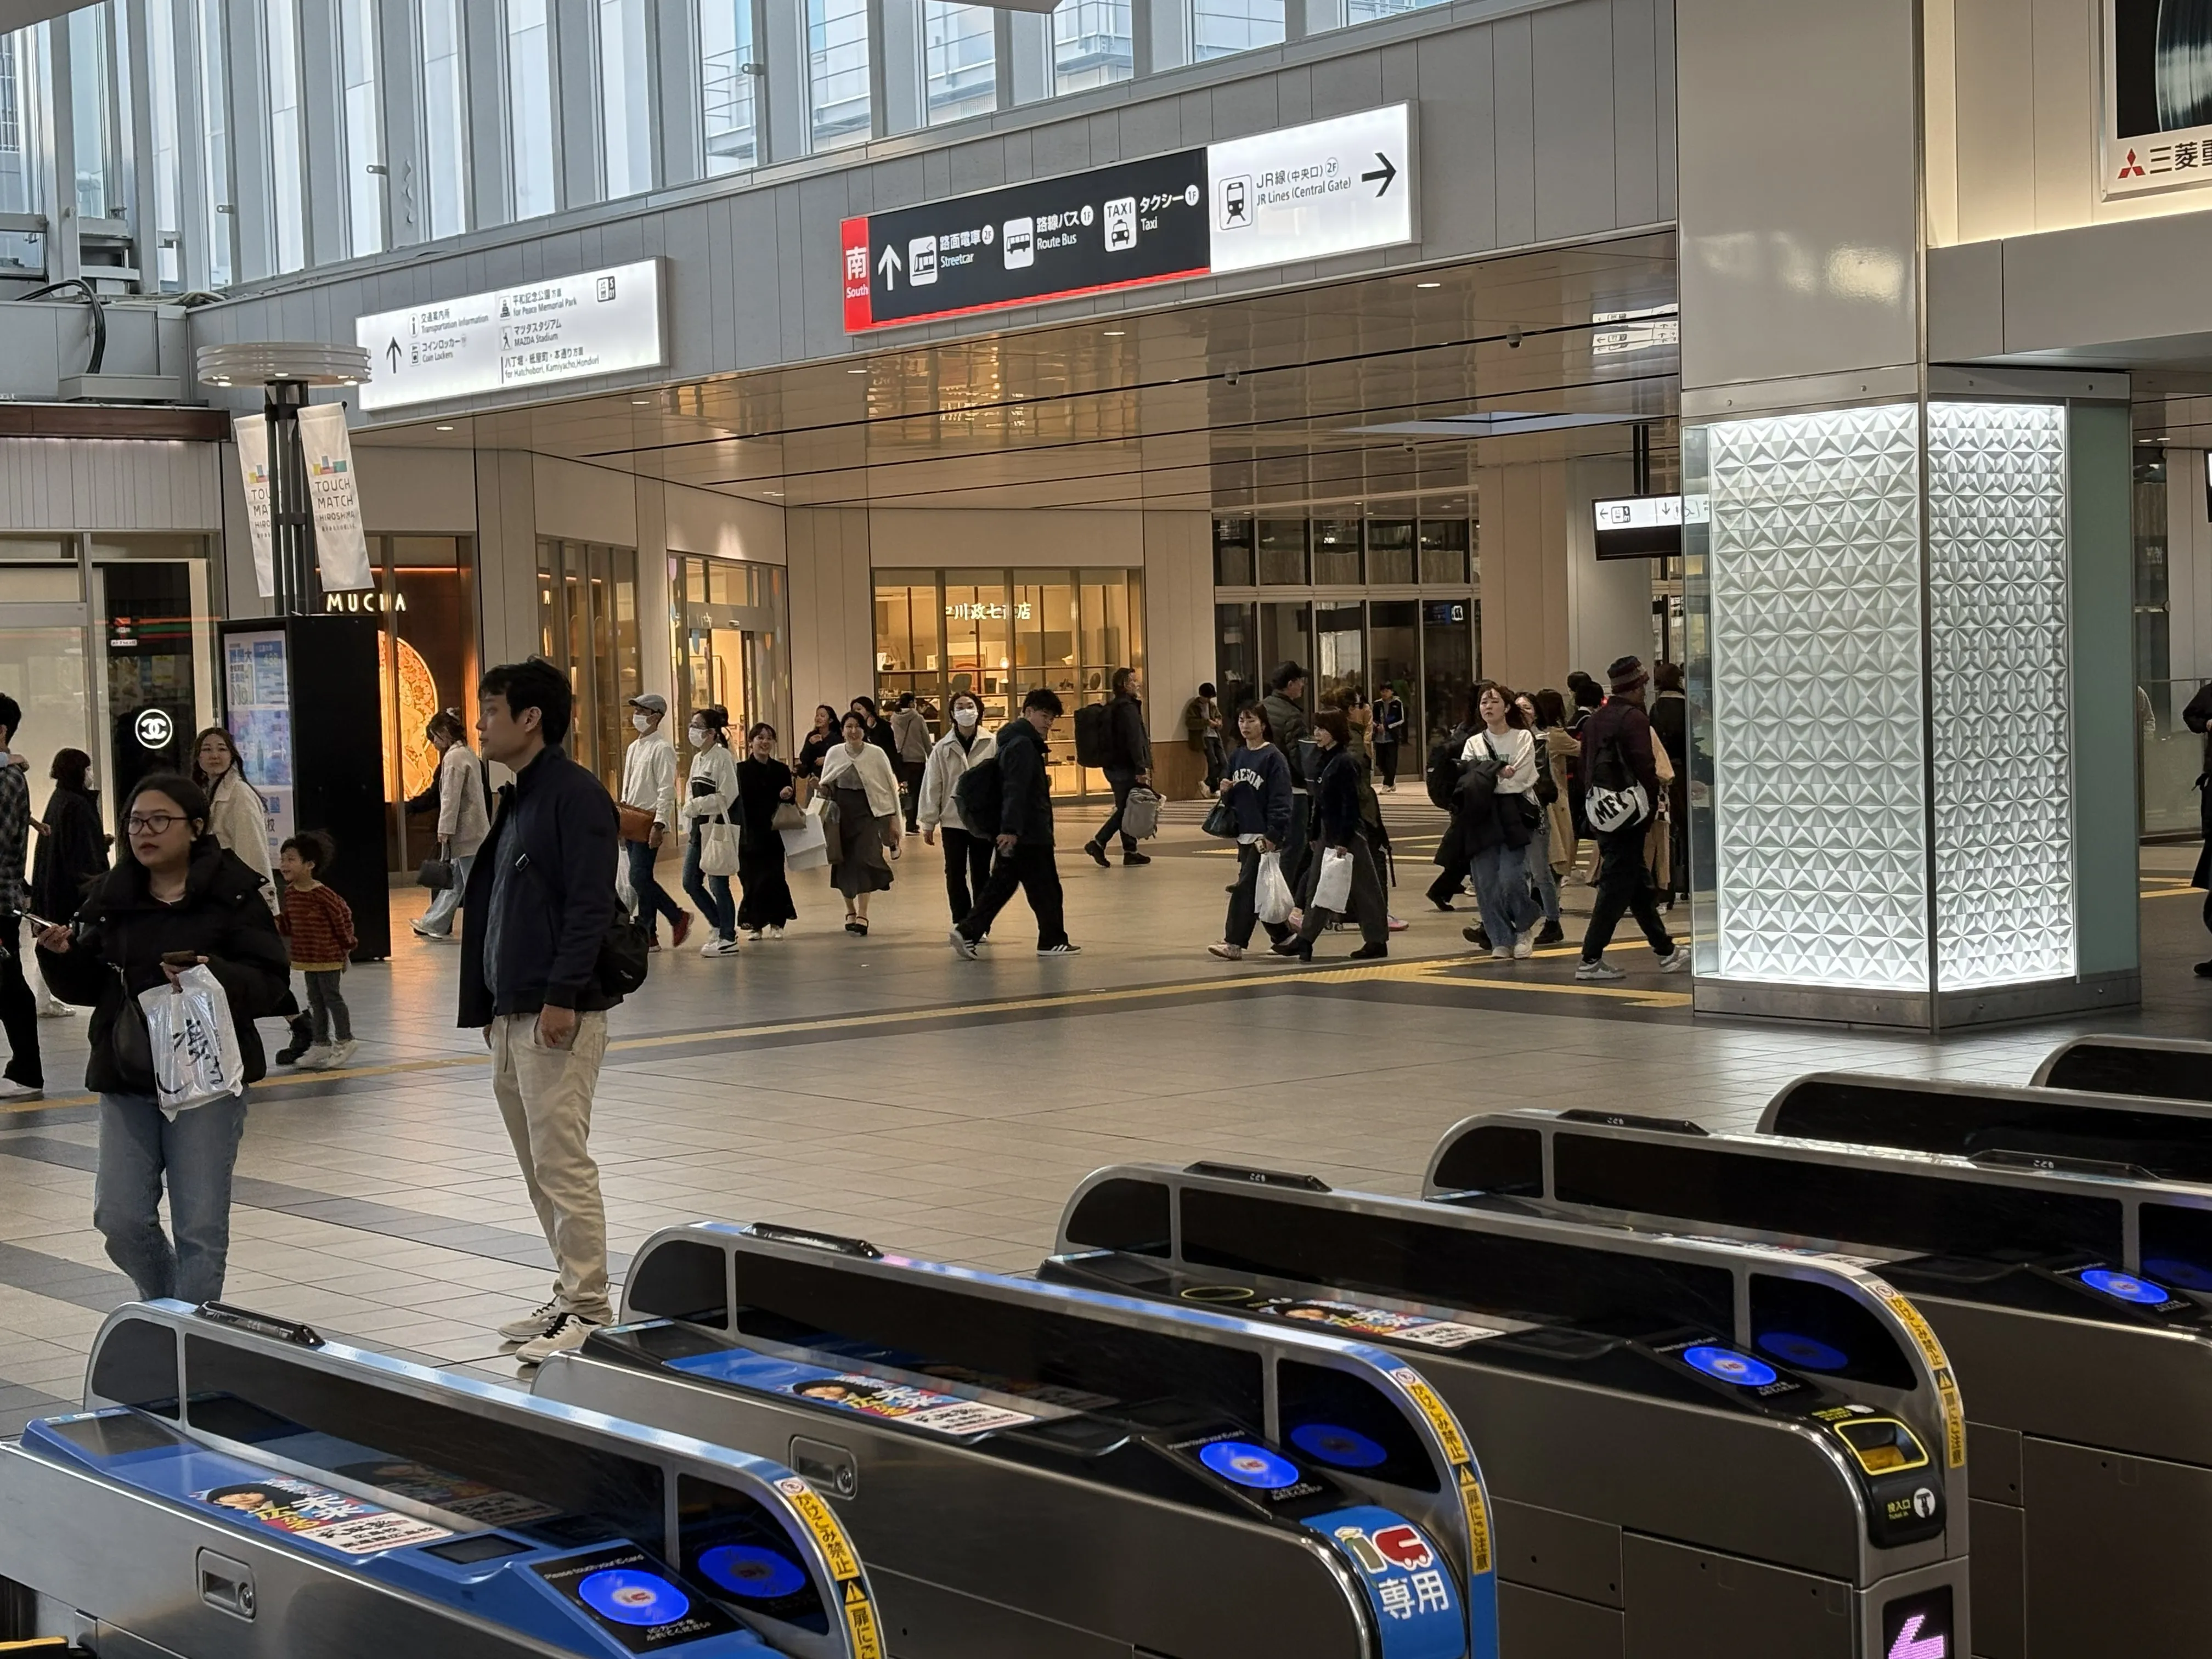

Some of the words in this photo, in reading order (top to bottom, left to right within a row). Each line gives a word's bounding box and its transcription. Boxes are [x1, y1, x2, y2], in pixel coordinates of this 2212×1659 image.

[1257, 193, 1266, 206] JR
[1268, 190, 1290, 204] Lines
[1292, 180, 1325, 199] (Central
[1328, 176, 1351, 192] Gate)
[1107, 202, 1132, 218] TAXI
[1139, 194, 1184, 213] タクシー
[1036, 211, 1080, 233] 路線バス
[1141, 216, 1158, 231] Taxi
[940, 229, 981, 251] 路面電車
[1037, 236, 1061, 250] Route
[1062, 233, 1077, 246] Bus
[846, 246, 867, 280] 南
[940, 253, 975, 268] Streetcar
[846, 284, 869, 298] South
[513, 308, 521, 316] for
[522, 306, 537, 315] Peace
[538, 298, 564, 313] Memorial
[565, 297, 577, 307] Park
[458, 314, 489, 327] Information
[422, 337, 461, 352] コインロッカー
[514, 336, 535, 347] MAZDA
[536, 332, 558, 343] Stadium
[422, 353, 434, 363] Coin
[435, 350, 454, 361] Lockers
[314, 478, 351, 493] TOUCH
[318, 494, 354, 509] MATCH
[253, 504, 270, 516] MA
[319, 511, 355, 521] HIROSHIMA
[945, 601, 1032, 620] 川政七店
[1232, 769, 1264, 791] REGON
[1379, 1569, 1449, 1620] 専用
